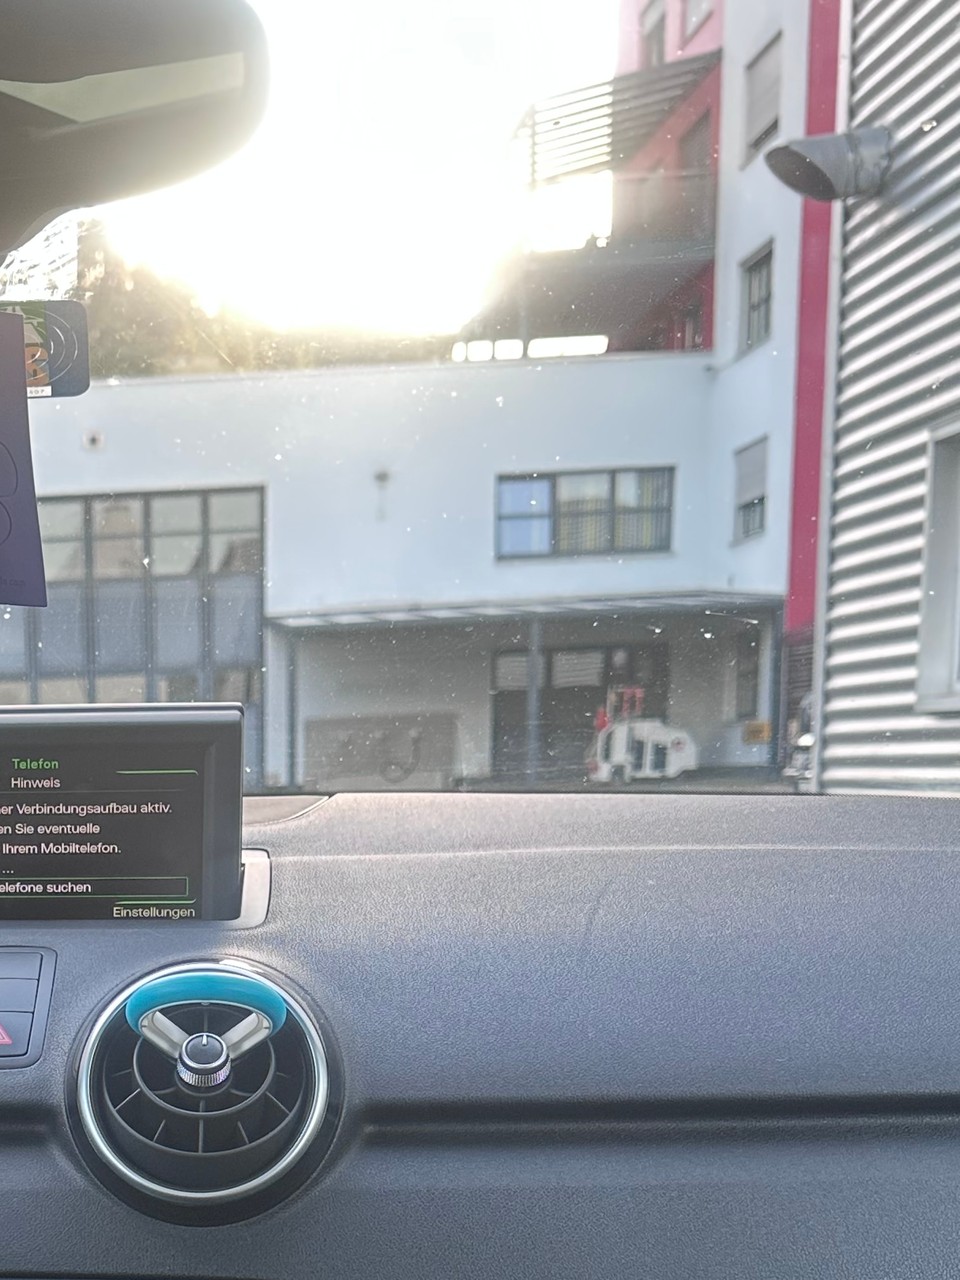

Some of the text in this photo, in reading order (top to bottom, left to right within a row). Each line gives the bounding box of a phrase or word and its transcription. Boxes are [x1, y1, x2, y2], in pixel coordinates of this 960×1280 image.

[12, 758, 59, 769] Telefon
[11, 777, 60, 788] Hinweis
[16, 802, 137, 816] Verbindungsaufbau
[140, 802, 172, 813] aktiv.
[15, 823, 34, 834] Sie
[37, 823, 100, 834] eventuelle
[2, 843, 38, 854] Ihrem
[41, 842, 121, 854] Mobiltelefon.
[46, 882, 91, 893] suchen
[113, 907, 195, 919] Einstellungen
